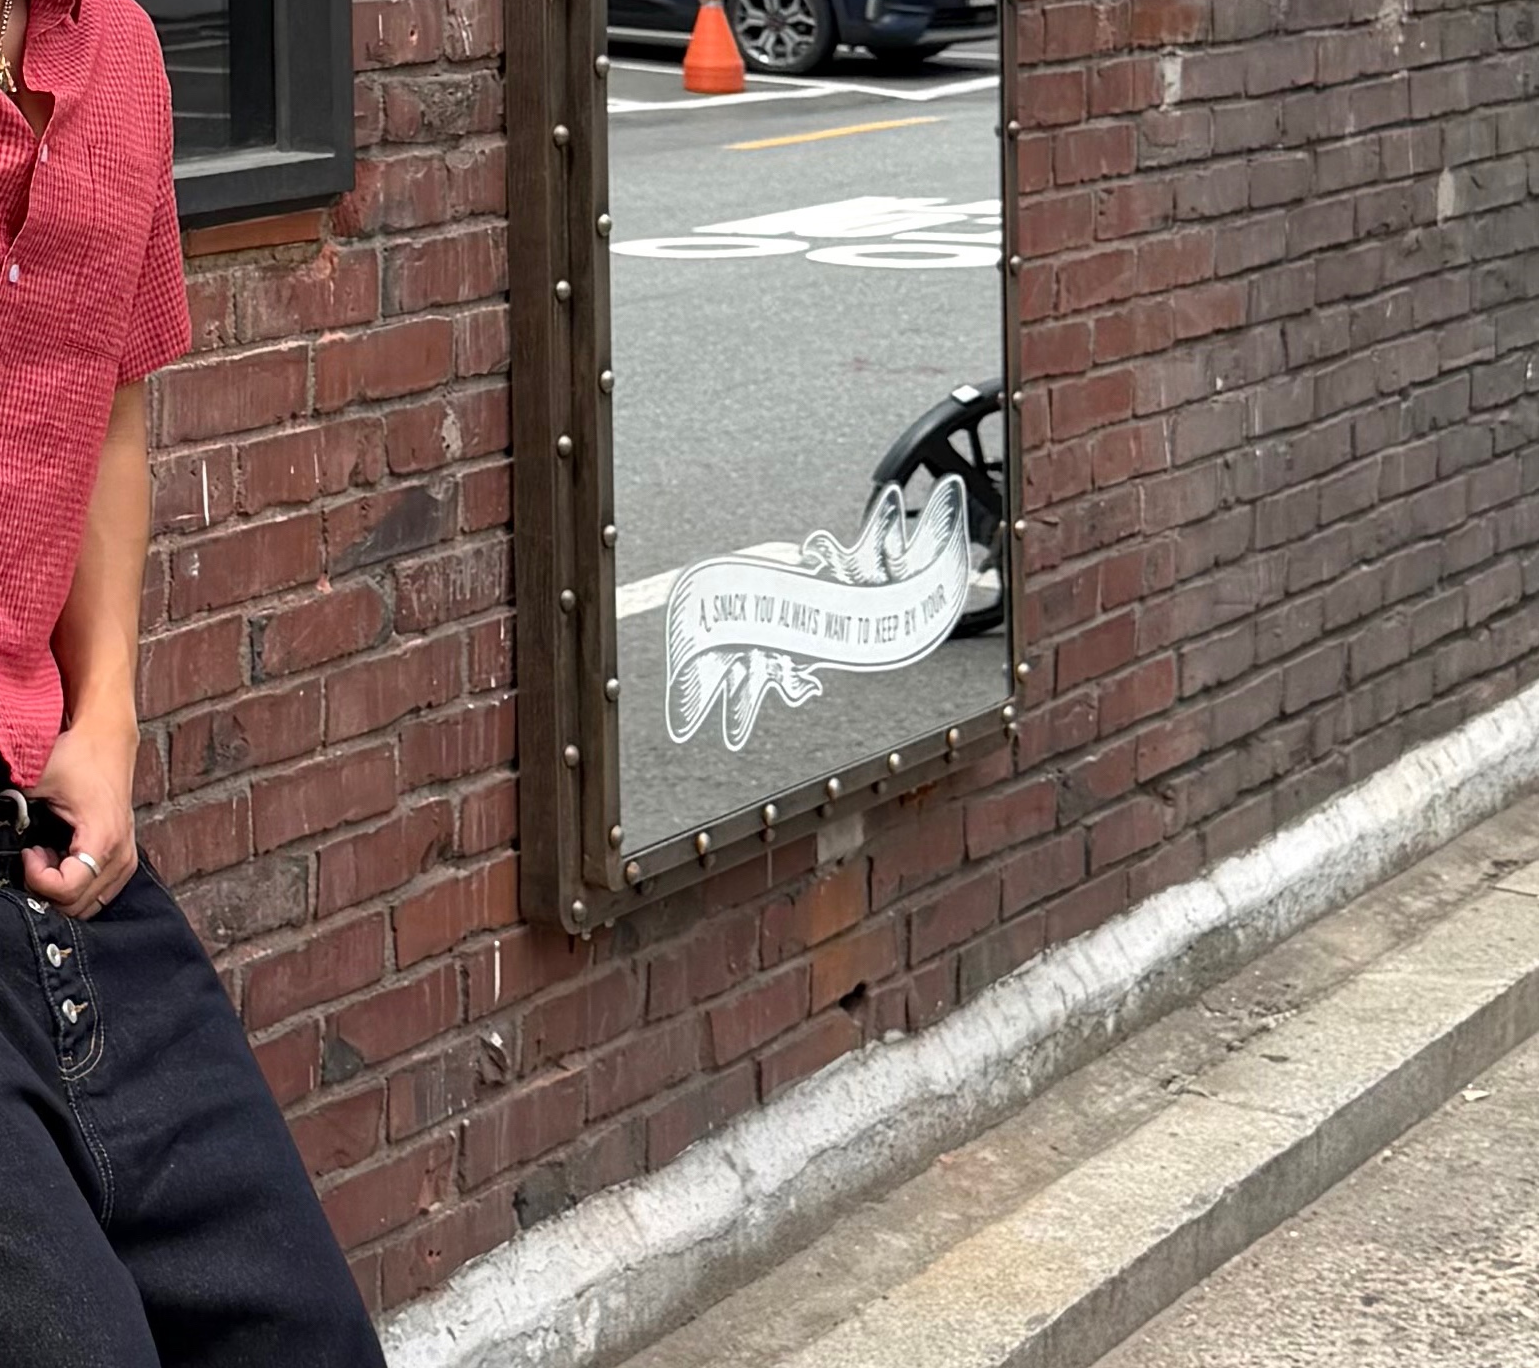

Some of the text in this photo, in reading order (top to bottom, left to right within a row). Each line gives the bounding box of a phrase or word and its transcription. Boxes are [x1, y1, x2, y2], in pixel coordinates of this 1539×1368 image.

[699, 583, 947, 644] A SNACK YOU ALWAYS WANT TO KEEP BY YOUR
